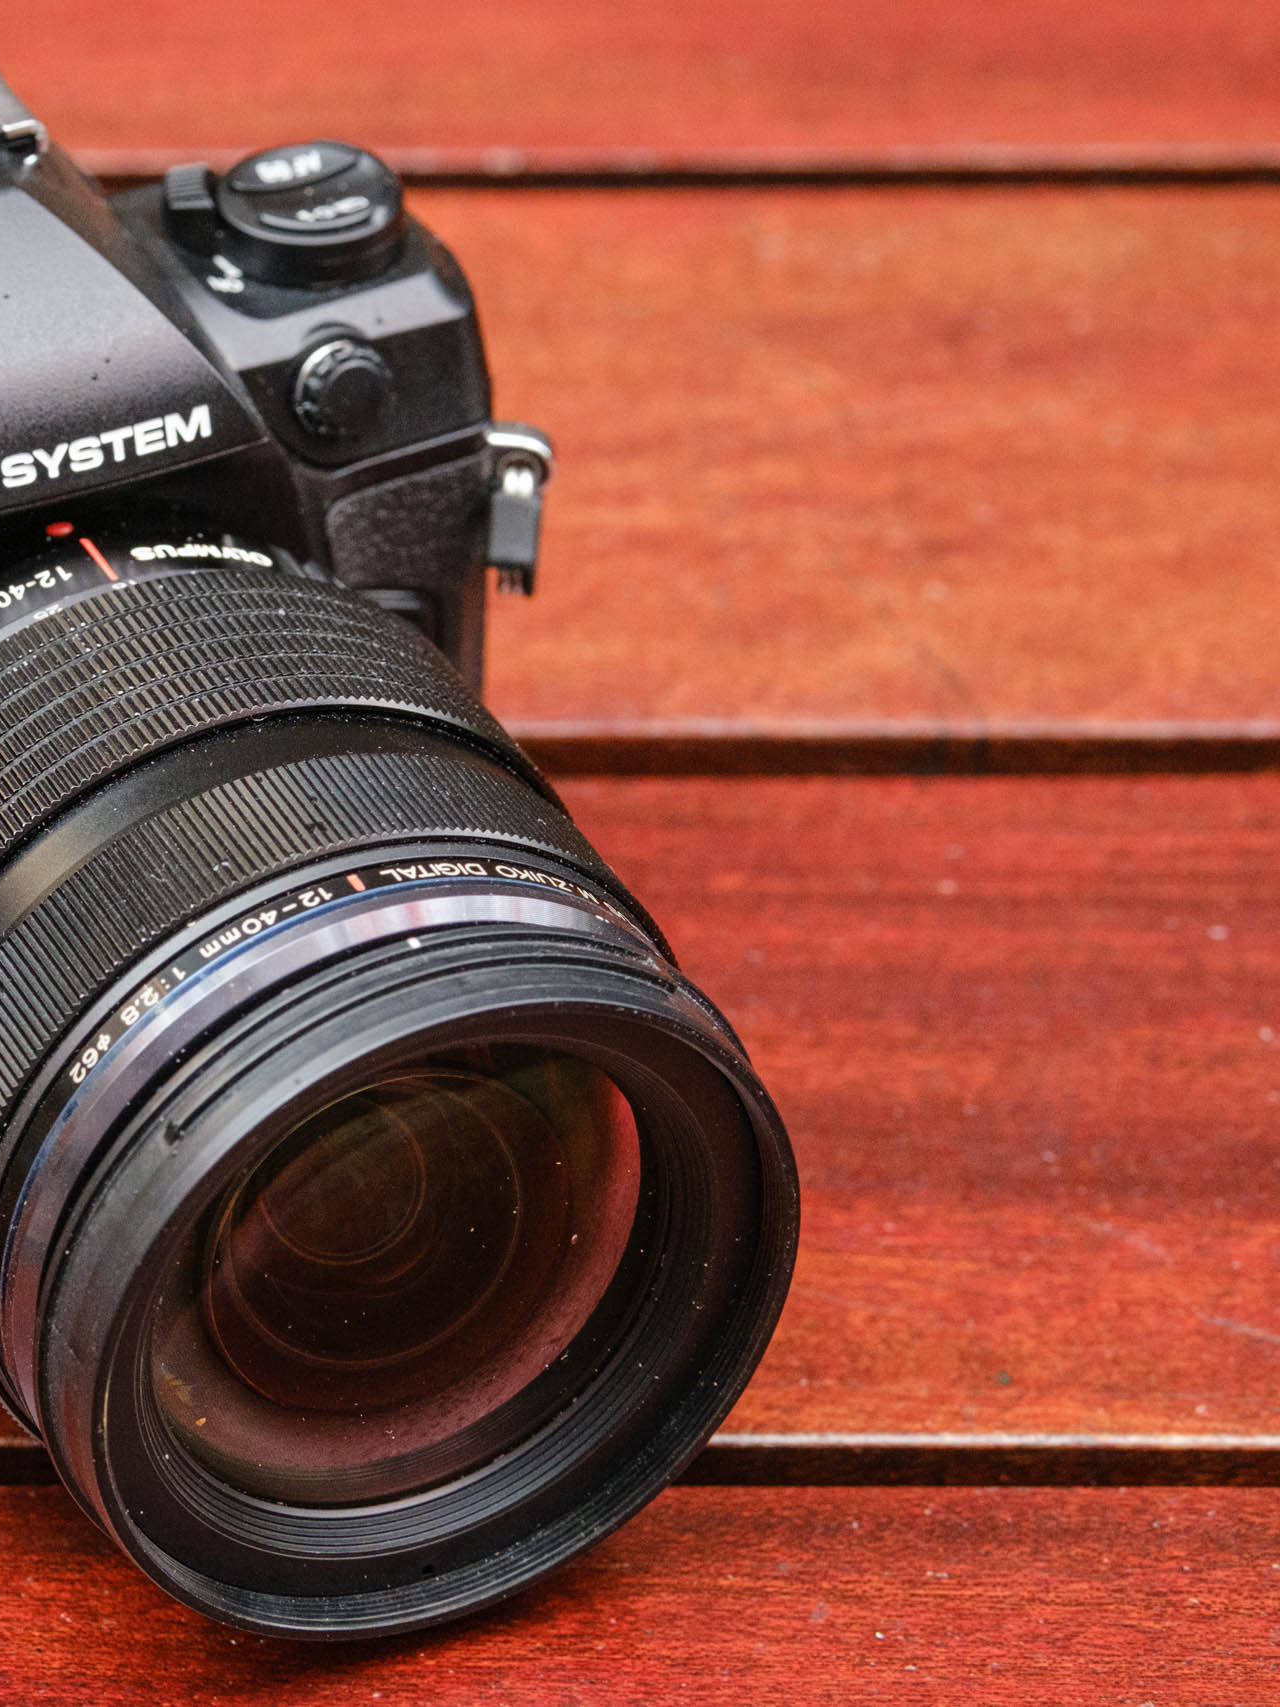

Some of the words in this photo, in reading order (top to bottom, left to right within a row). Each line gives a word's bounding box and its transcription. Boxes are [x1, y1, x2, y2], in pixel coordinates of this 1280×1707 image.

[0, 404, 212, 489] SYSTEM
[129, 536, 274, 568] OLYMPUS
[379, 862, 488, 882] DIGITAL
